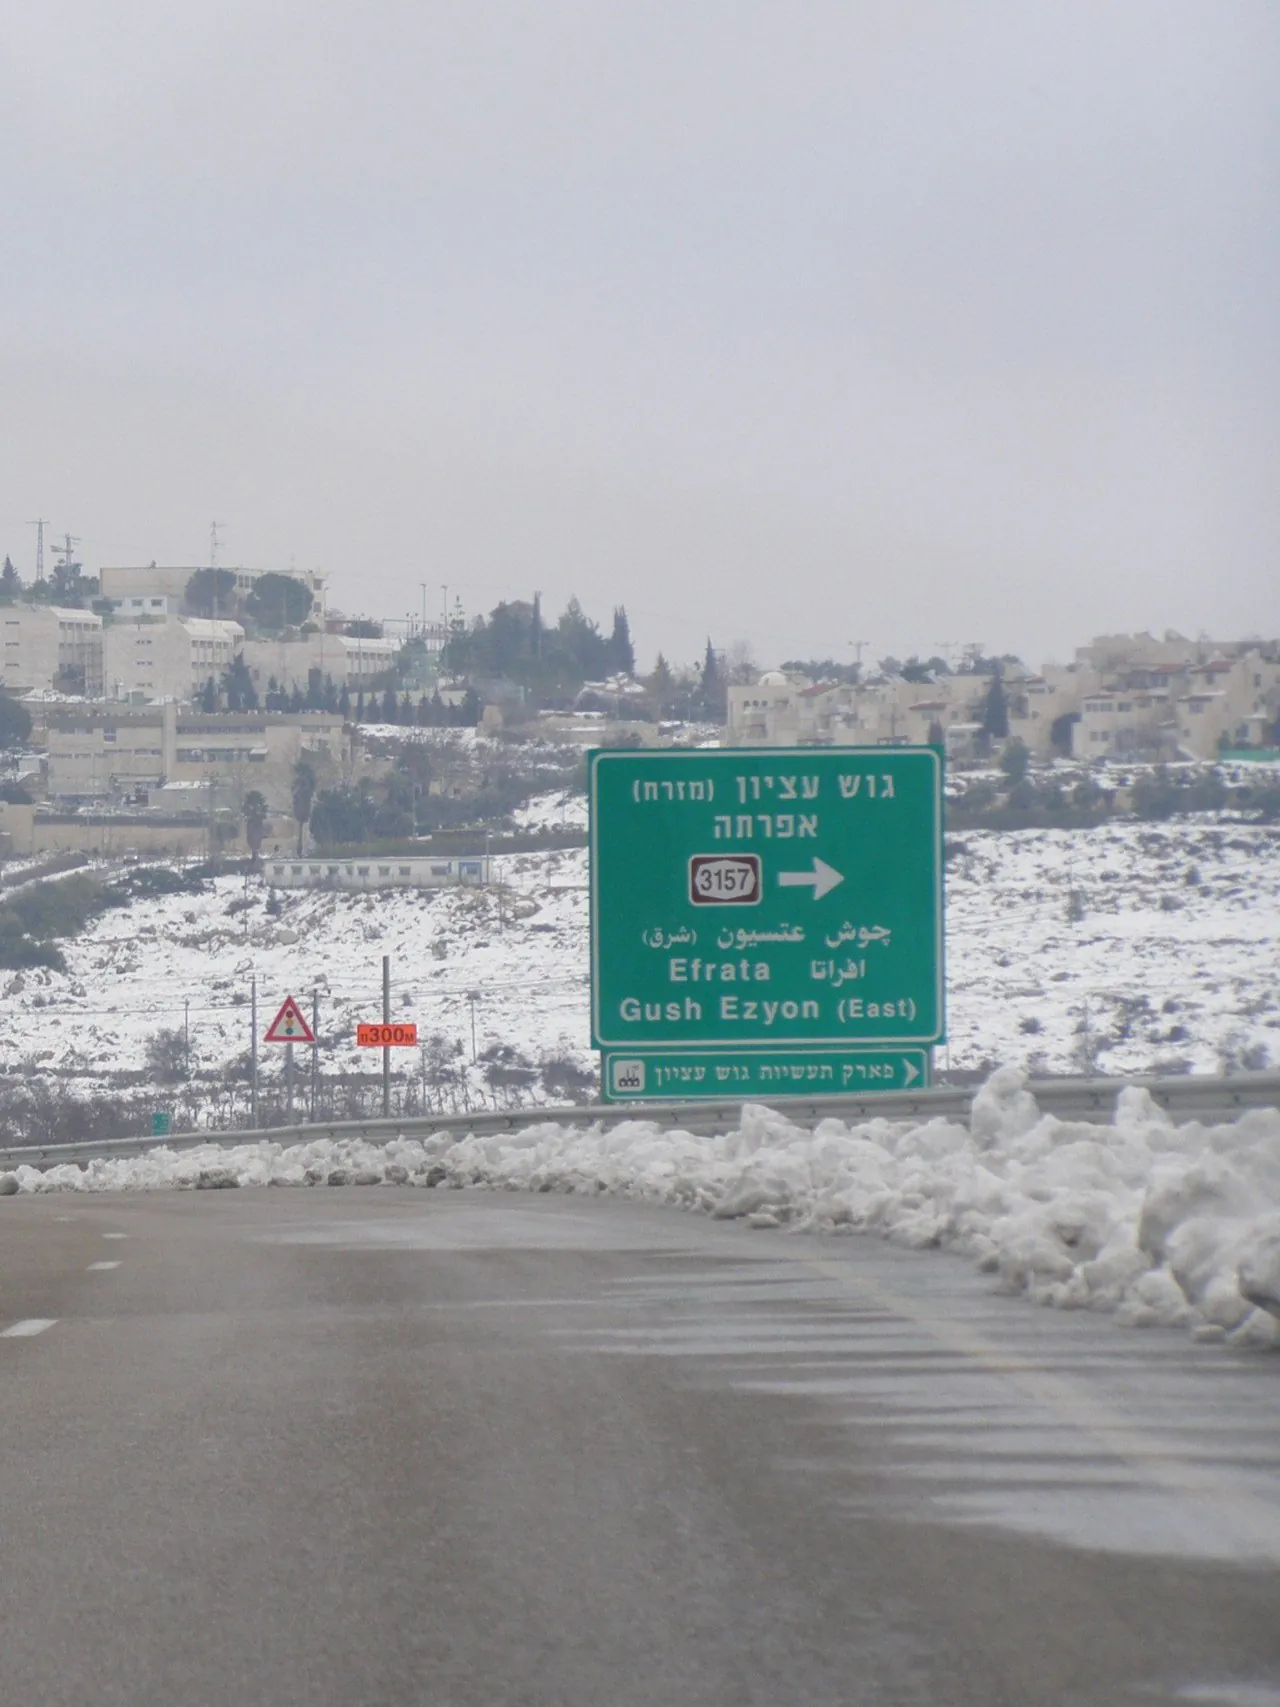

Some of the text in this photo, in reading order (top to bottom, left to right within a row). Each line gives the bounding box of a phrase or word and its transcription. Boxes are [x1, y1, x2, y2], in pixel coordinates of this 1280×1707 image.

[632, 774, 895, 804] גוש עציון (מזרח)
[713, 814, 818, 839] אפרתה
[699, 868, 750, 891] 3157
[641, 925, 698, 949] (شرق)
[669, 958, 771, 981] Efrata
[619, 996, 917, 1025] Gush Ezyon (East)
[654, 1063, 895, 1088] פארק תעשיות גוש עציון
